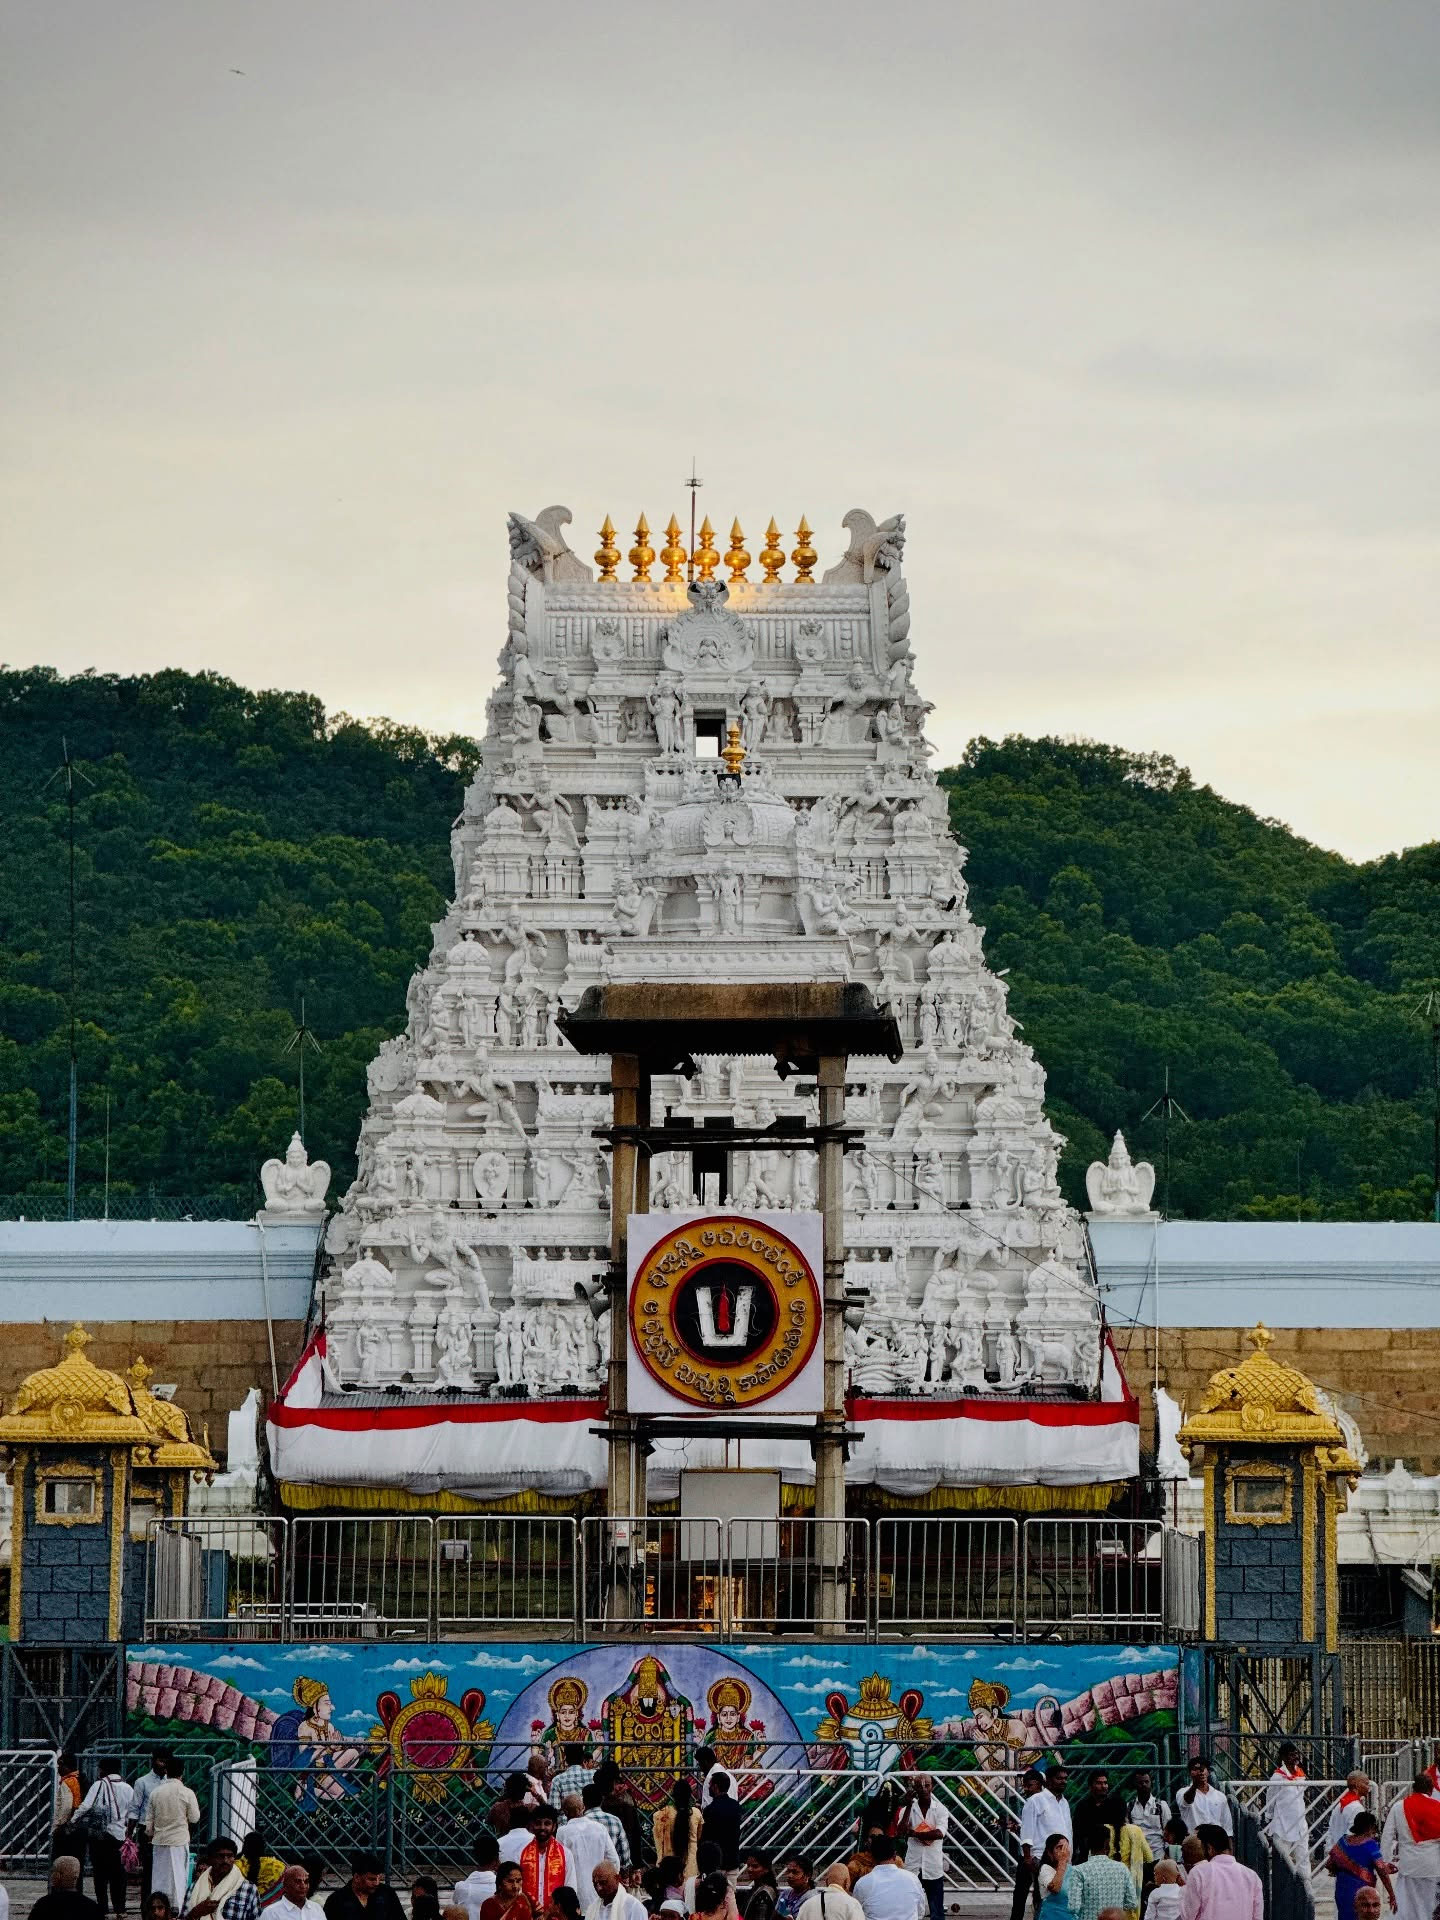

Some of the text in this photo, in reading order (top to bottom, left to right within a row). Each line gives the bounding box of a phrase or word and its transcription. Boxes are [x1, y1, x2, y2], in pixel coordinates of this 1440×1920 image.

[648, 1225, 806, 1288] ధర్మాన్ని ఆచరించండి
[643, 1299, 659, 1314] ఆ
[736, 1297, 808, 1392] కాపాడుతుంది
